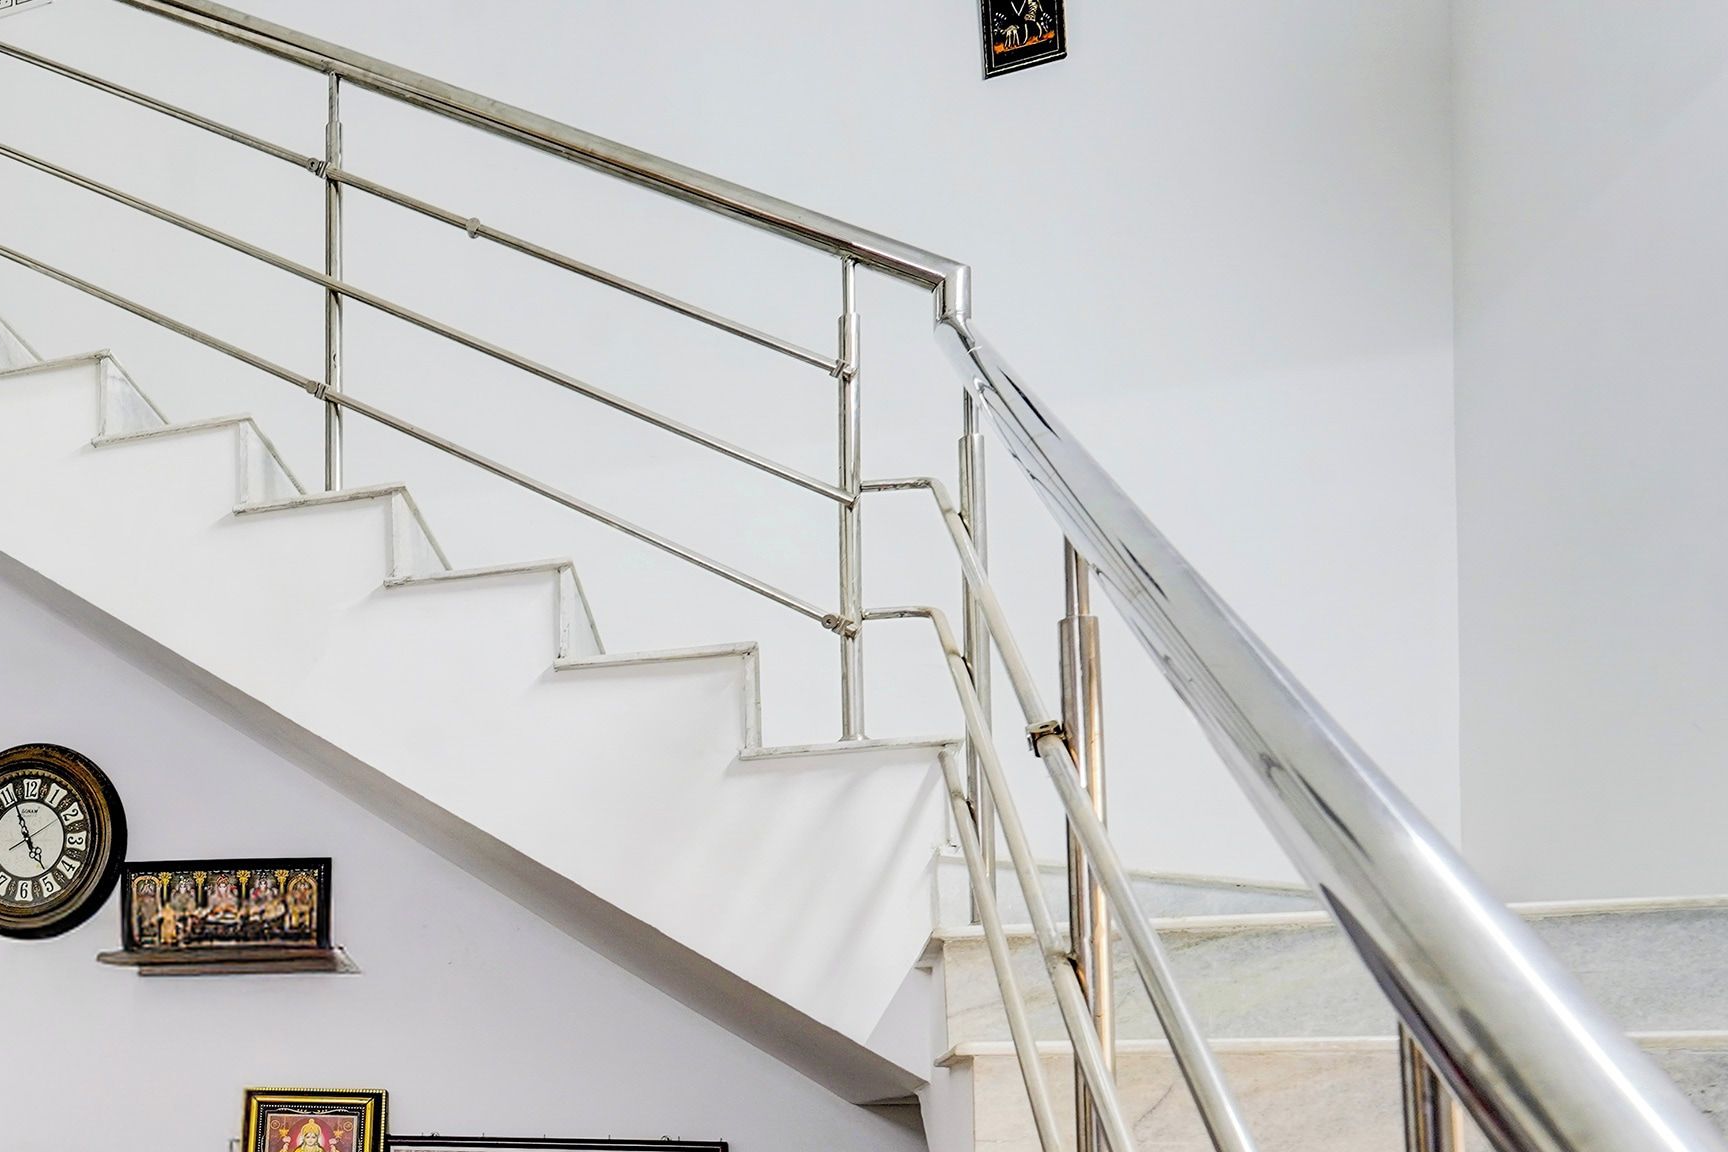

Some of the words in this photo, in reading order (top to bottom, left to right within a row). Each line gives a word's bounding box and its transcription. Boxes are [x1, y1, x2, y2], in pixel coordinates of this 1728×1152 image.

[25, 781, 38, 798] 12
[49, 789, 60, 804] 1
[62, 809, 79, 822] 2
[67, 836, 84, 845] 3
[61, 860, 76, 872] 4
[20, 882, 28, 898] 6
[42, 876, 54, 892] 5
